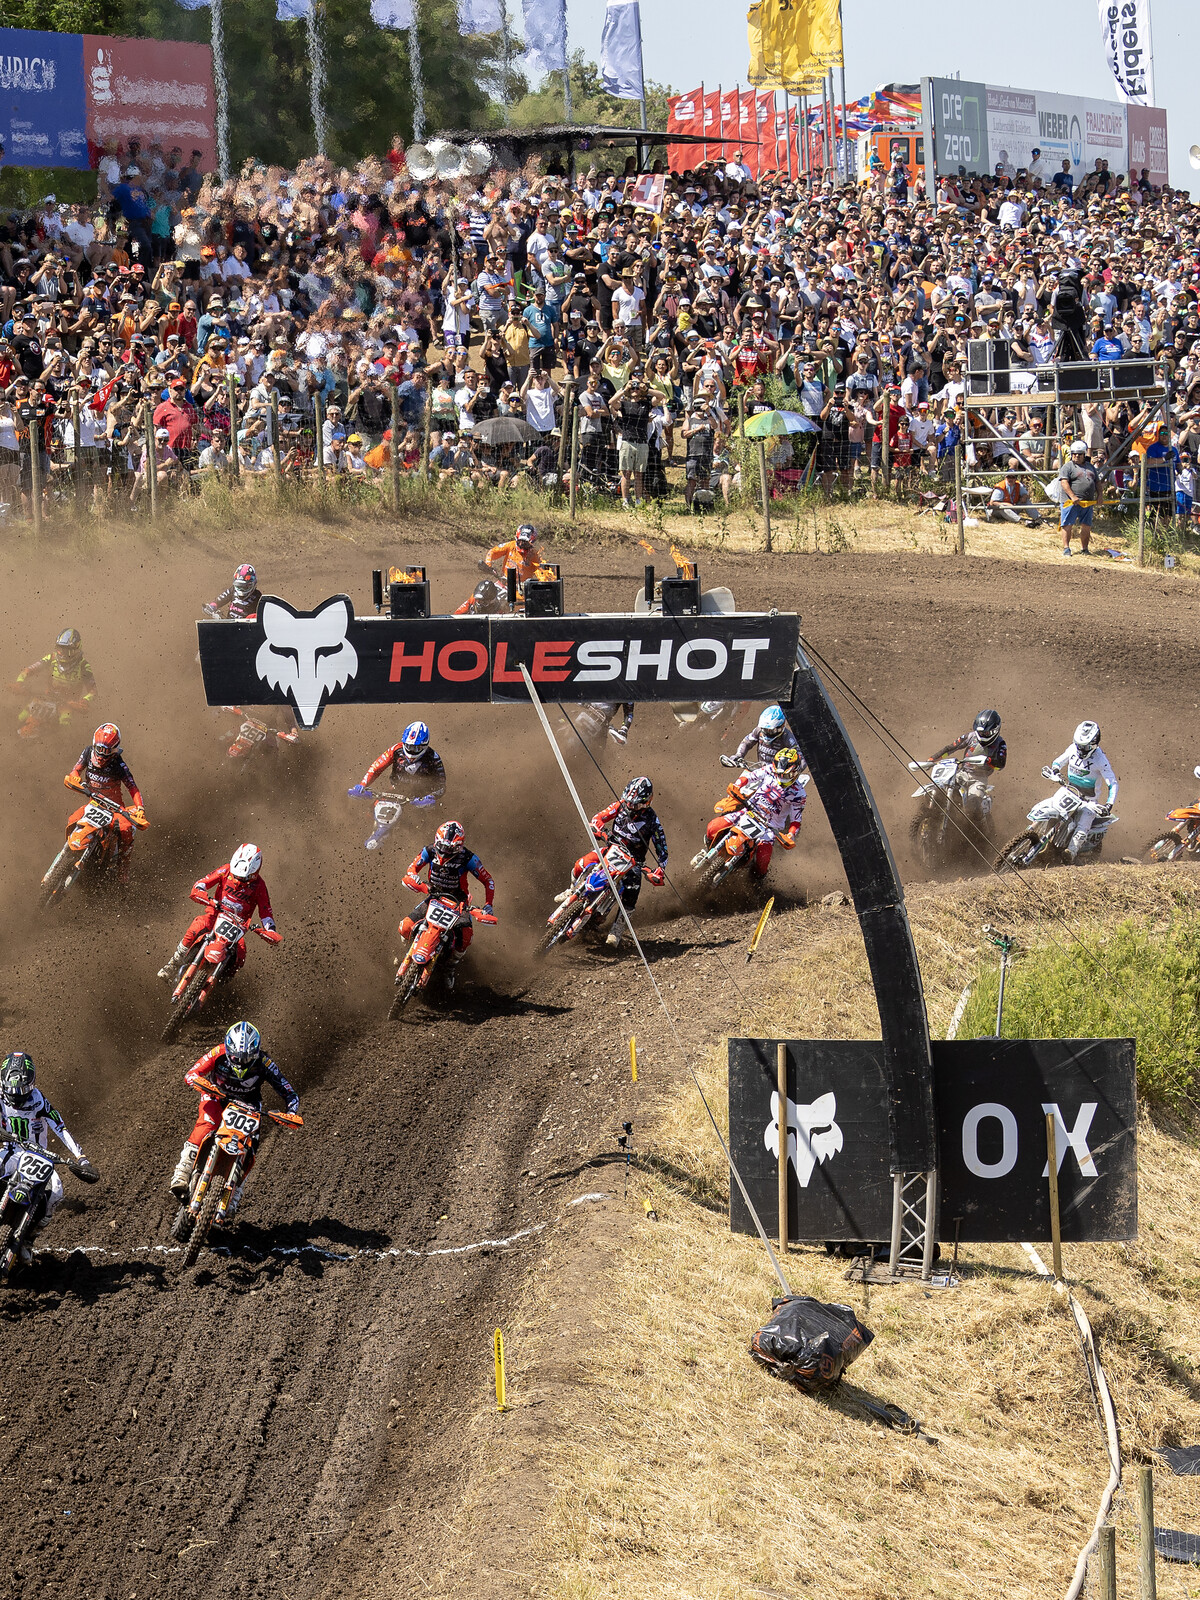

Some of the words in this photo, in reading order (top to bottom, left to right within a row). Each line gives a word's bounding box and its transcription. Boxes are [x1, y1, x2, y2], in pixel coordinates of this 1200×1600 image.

[1038, 111, 1069, 140] WEBER
[1132, 133, 1146, 163] Louis
[389, 638, 770, 682] HOLESHOT
[86, 808, 111, 827] 226
[741, 818, 762, 838] 71
[224, 885, 251, 901] THOR
[429, 908, 455, 927] 92
[216, 920, 242, 942] 89
[224, 1083, 257, 1093] YUASA
[225, 1111, 257, 1134] 303
[962, 1102, 1099, 1178] OX
[19, 1156, 53, 1181] 259
